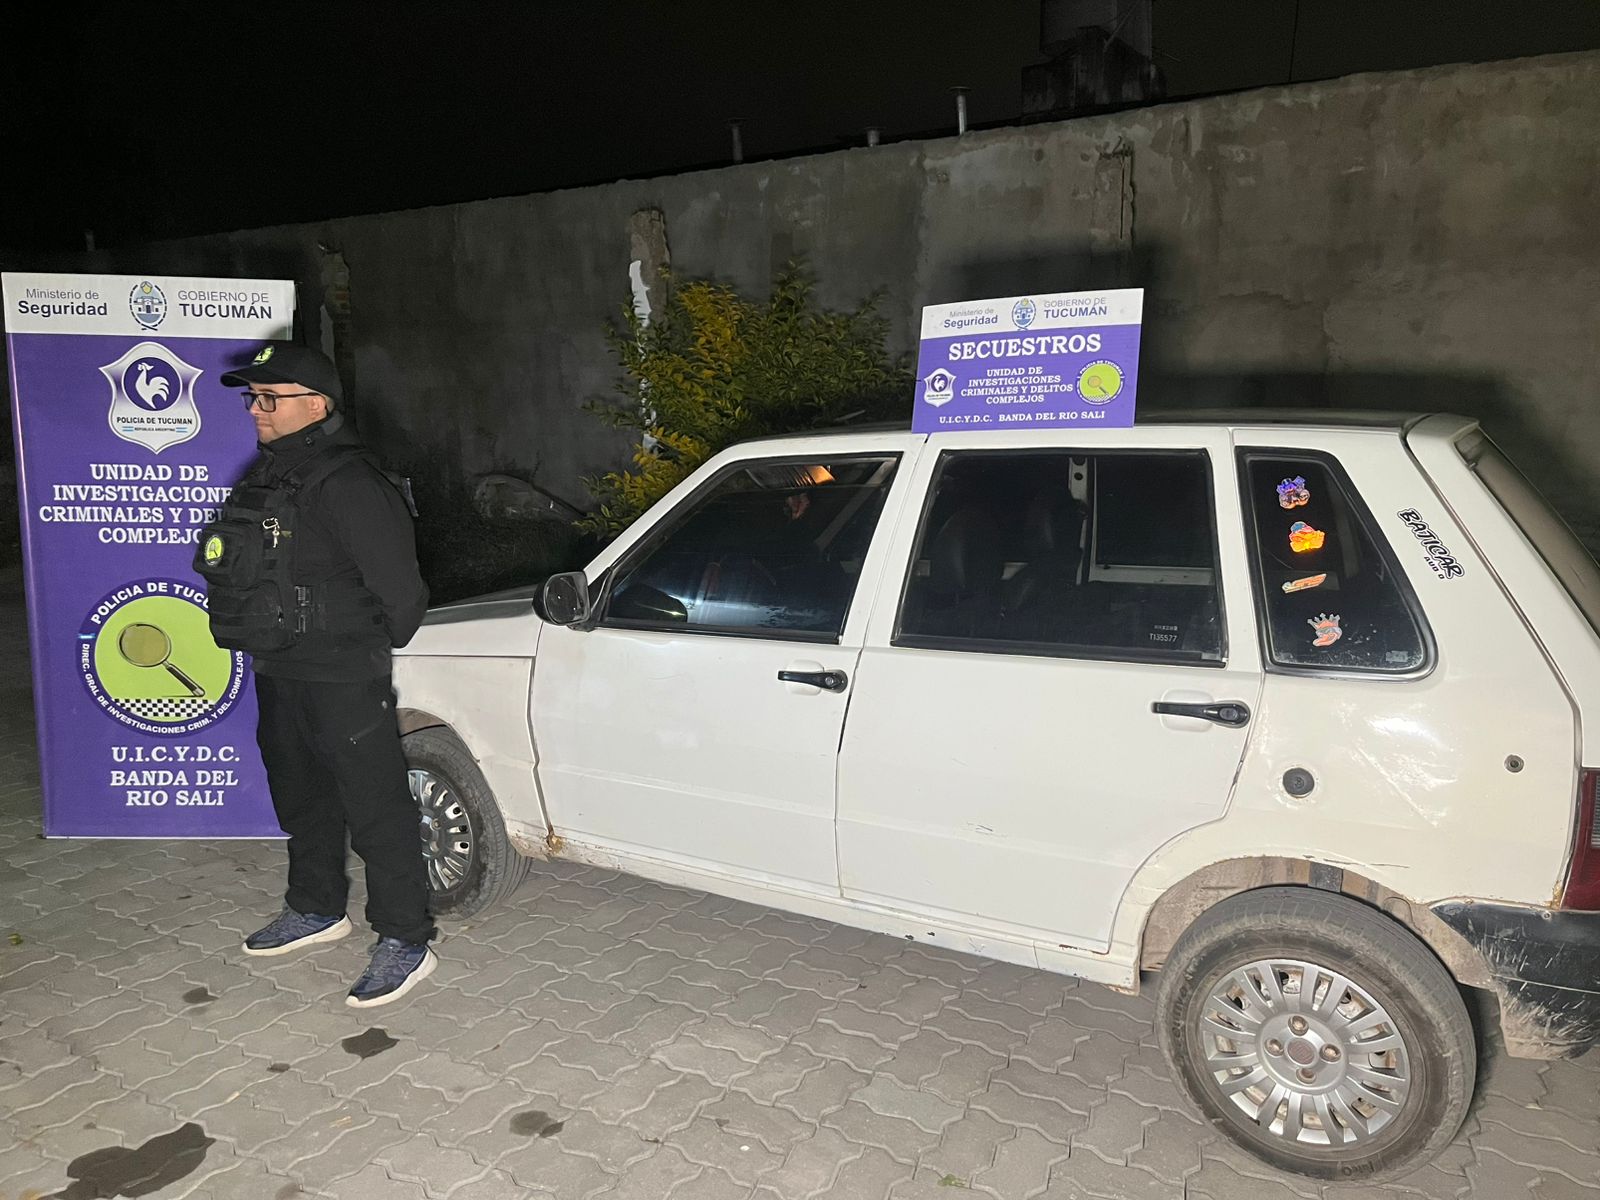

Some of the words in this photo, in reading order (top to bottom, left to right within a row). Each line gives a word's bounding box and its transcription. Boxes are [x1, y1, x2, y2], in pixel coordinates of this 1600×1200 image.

[26, 288, 82, 300] Ministerio
[84, 290, 99, 300] de
[178, 290, 248, 303] GOBIERNO
[251, 292, 269, 303] DE
[18, 300, 108, 318] Seguridad
[179, 302, 273, 319] TUCUMÁN
[1043, 298, 1092, 308] GOBIERNO
[1094, 297, 1106, 305] DE
[950, 309, 983, 318] Ministerio
[1044, 304, 1107, 319] TUCUMÁN
[943, 315, 998, 329] Seguridad
[949, 333, 1101, 361] SECUESTROS
[986, 367, 1025, 377] UNIDAD
[1028, 366, 1043, 375] DE
[968, 375, 1061, 388] INVESTIGACIONES
[960, 387, 1018, 397] CRIMINALES
[1021, 386, 1028, 394] Y
[1030, 384, 1073, 394] DELITOS
[986, 394, 1044, 405] COMPLEJOS
[116, 416, 145, 424] POLICIA
[157, 417, 193, 425] TUCUMAN
[939, 415, 993, 424] U.I.C.Y.D.C.
[999, 413, 1032, 422] BANDA
[1035, 412, 1056, 421] DEL
[1059, 411, 1078, 420] RIO
[1081, 410, 1105, 419] SALI
[90, 463, 172, 481] UNIDAD
[179, 465, 208, 481] DE
[53, 484, 233, 503] INVESTIGACIONE
[39, 505, 164, 523] CRIMINALES
[169, 507, 183, 523] Y
[1398, 509, 1464, 578] BATICAR
[90, 584, 143, 624] POLICIA
[147, 582, 168, 593] DE
[81, 643, 90, 672] DIREC.
[228, 650, 243, 700] COMPLEJOS
[85, 673, 100, 696] GRAL
[97, 695, 109, 707] DE
[107, 706, 186, 734] INVESTIGACIONES
[187, 717, 213, 731] CRIM.
[111, 746, 240, 762] U.I.C.Y.D.C.
[110, 770, 189, 786] BANDA
[195, 770, 239, 786] DEL
[126, 790, 169, 806] RIO
[175, 790, 225, 806] SALI
